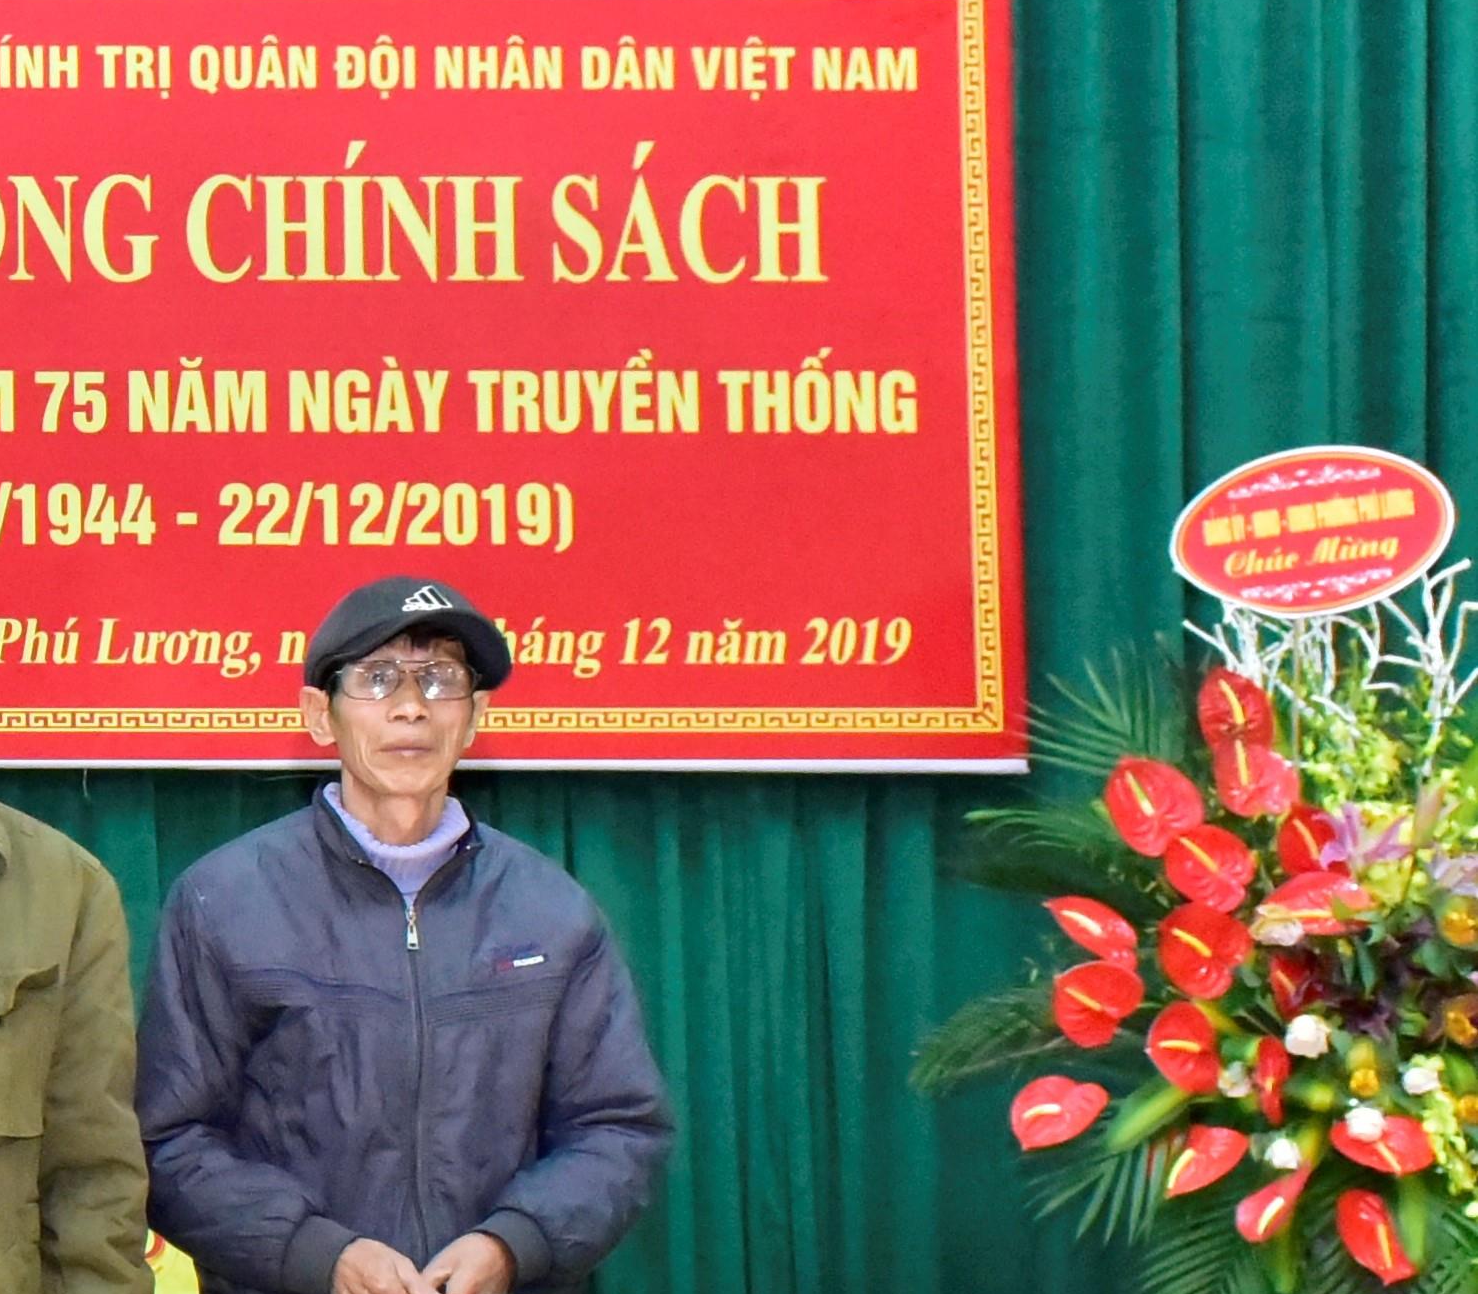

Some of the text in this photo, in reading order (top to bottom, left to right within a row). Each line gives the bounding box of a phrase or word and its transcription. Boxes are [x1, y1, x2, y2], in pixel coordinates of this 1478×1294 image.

[96, 45, 171, 100] TRỊ
[190, 35, 318, 95] QUÂN
[334, 35, 417, 100] ĐỘI
[435, 35, 563, 90] NHÂN
[581, 36, 675, 91] DÂN
[691, 37, 797, 101] VIỆT
[813, 47, 918, 92] NAM
[187, 141, 524, 284] CHÍNH
[552, 141, 828, 284] SÁCH
[35, 371, 107, 434] 75
[129, 357, 267, 433] NĂM
[289, 356, 449, 434] NGÀY
[468, 349, 700, 434] TRUYỀN
[718, 348, 918, 434] THỐNG
[177, 512, 198, 525] -
[219, 481, 574, 553] 22/12/2019)
[1223, 546, 1300, 579] Chúc
[95, 618, 262, 678] Lương,
[494, 616, 605, 679] háng
[621, 618, 672, 665] 12
[686, 619, 787, 665] năm
[800, 618, 912, 665] 2019
